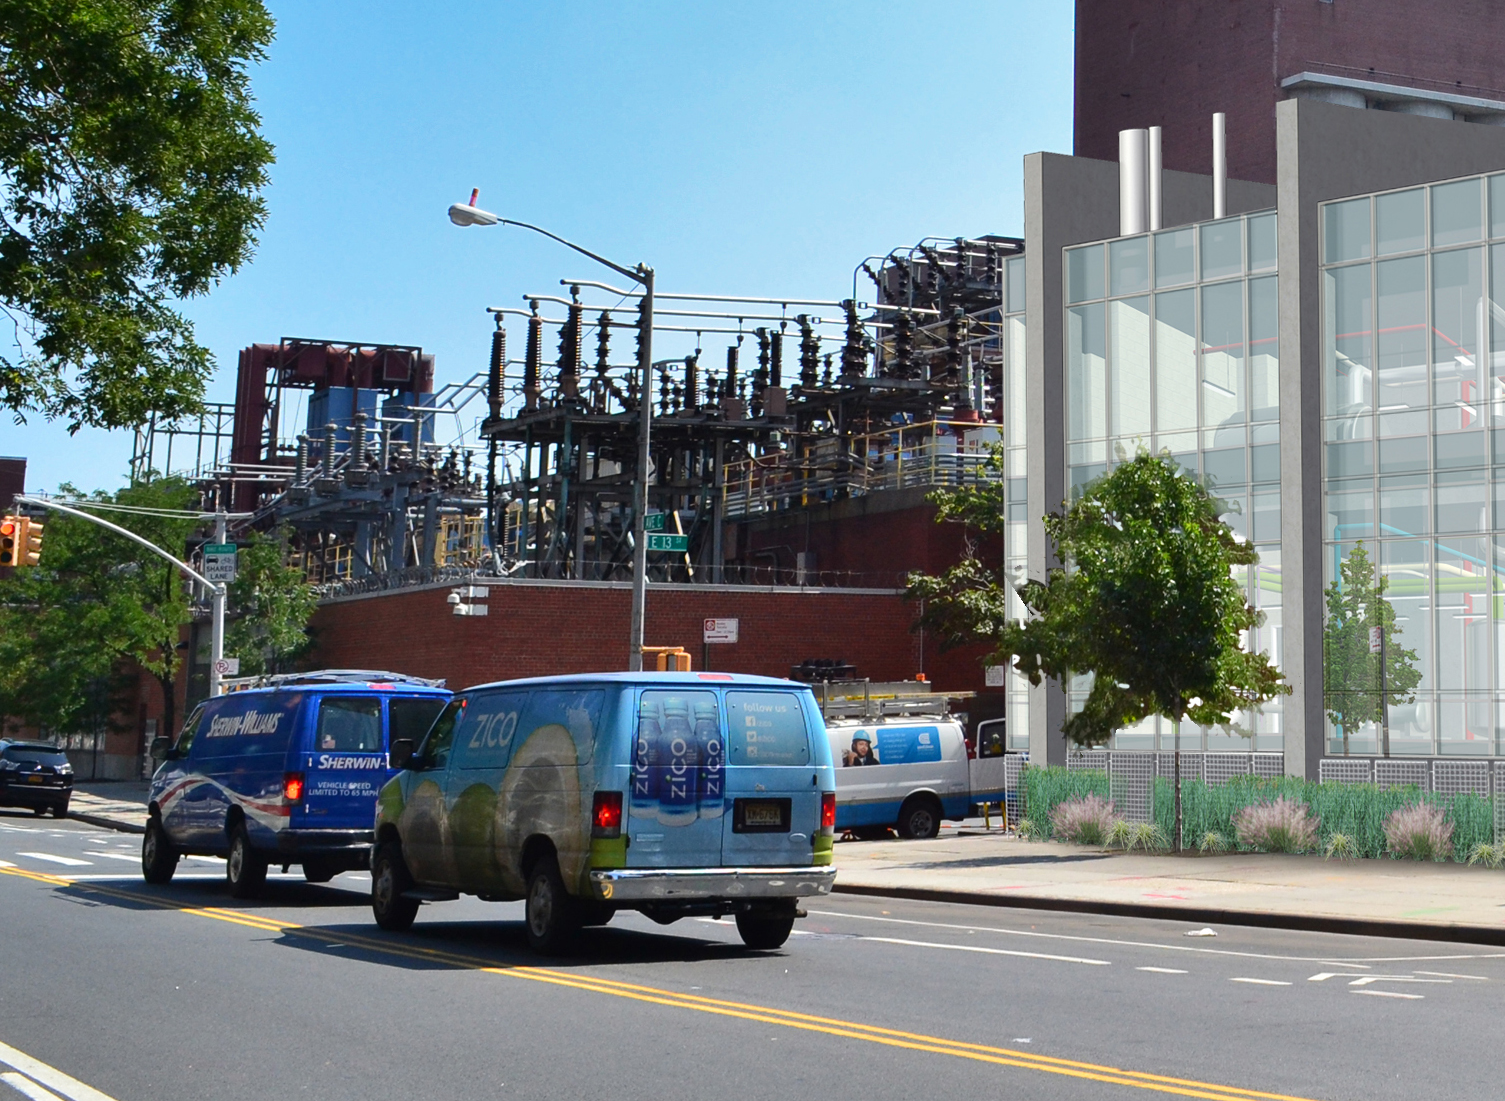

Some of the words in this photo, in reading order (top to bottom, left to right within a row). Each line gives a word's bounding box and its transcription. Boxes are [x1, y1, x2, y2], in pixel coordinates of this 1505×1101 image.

[644, 516, 656, 529] AVE
[657, 515, 662, 527] C
[651, 536, 658, 549] E
[662, 536, 672, 549] 13
[743, 702, 773, 712] follow
[775, 704, 787, 713] us
[468, 711, 518, 749] ZICO
[636, 739, 648, 795] ZICO
[671, 738, 687, 799] ZICO
[707, 739, 720, 795] ZICO
[318, 781, 347, 789] VEHICLE
[361, 789, 379, 797] MPH
